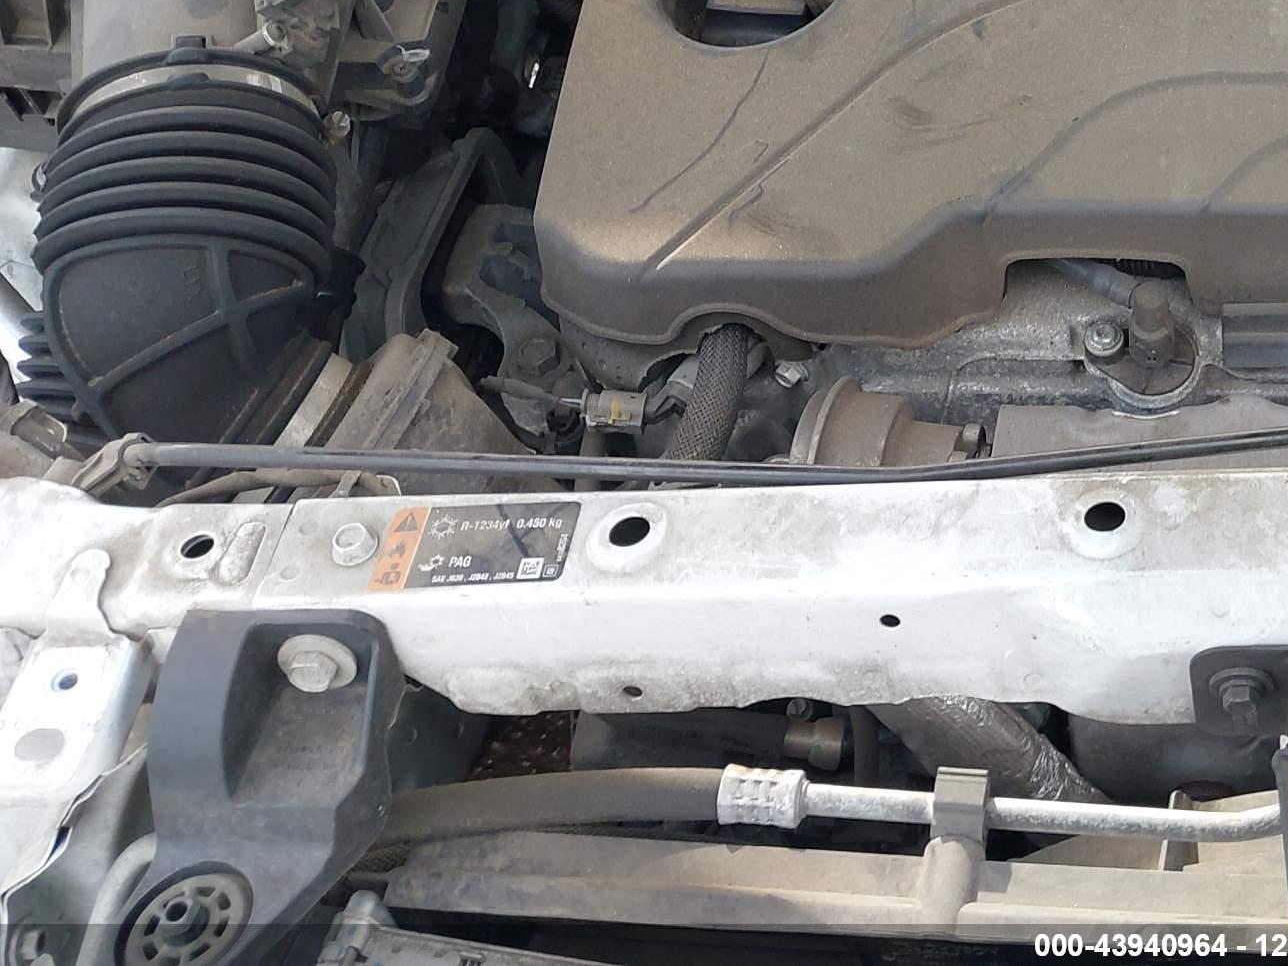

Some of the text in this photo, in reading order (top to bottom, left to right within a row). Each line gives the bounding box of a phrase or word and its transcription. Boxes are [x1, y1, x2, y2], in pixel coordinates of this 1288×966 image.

[460, 517, 563, 530] R-1234yf 0.450 kg
[448, 556, 473, 568] PAG
